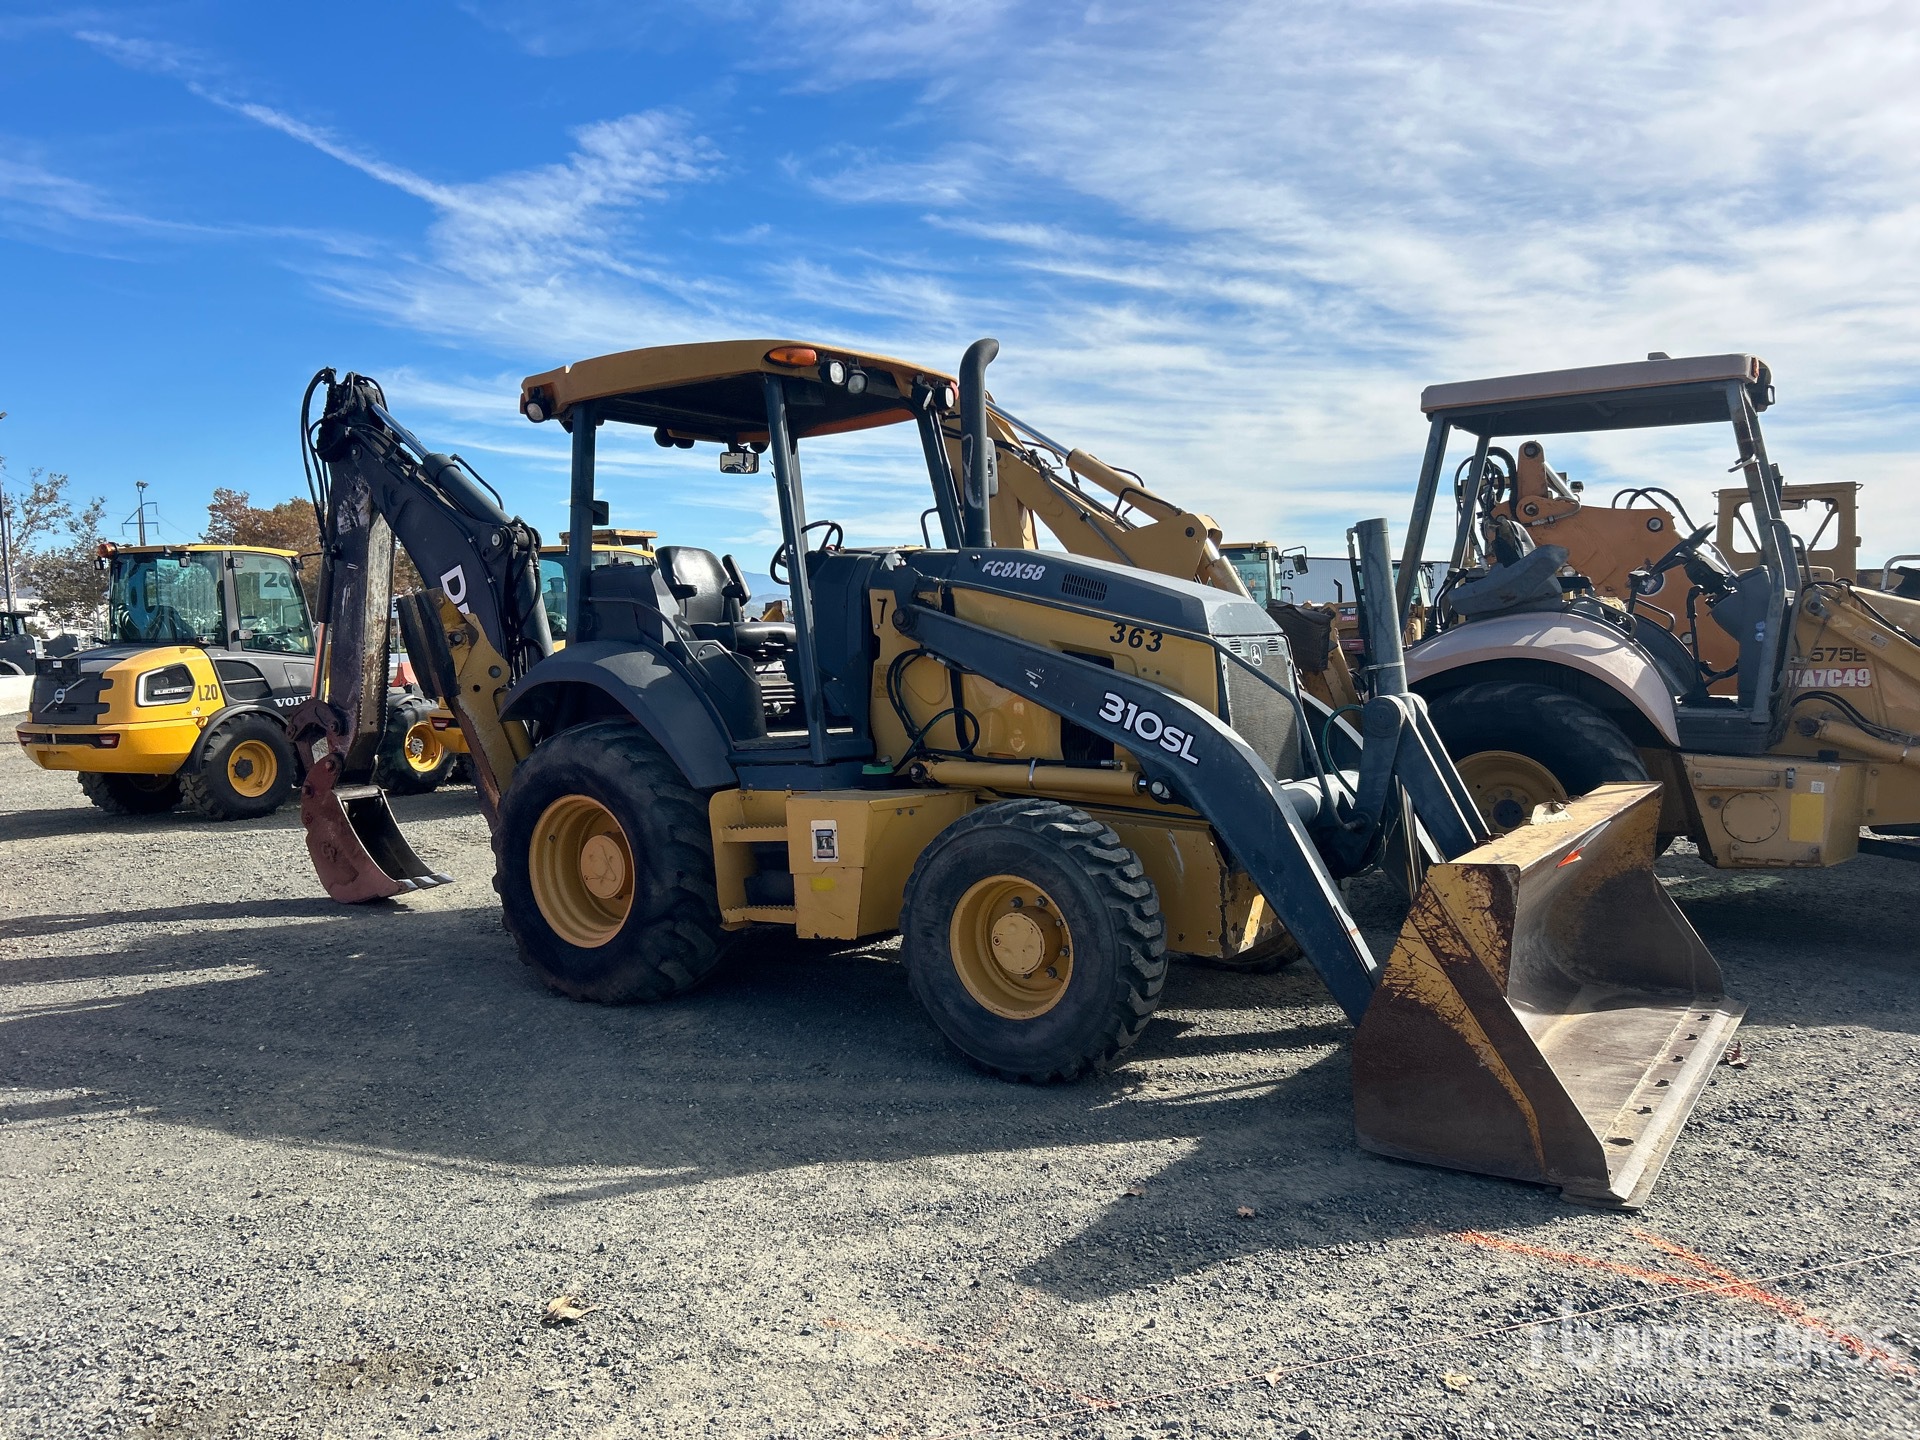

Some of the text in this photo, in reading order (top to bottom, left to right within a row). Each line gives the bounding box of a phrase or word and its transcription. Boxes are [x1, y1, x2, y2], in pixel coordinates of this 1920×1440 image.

[981, 560, 1046, 581] FC8X58
[877, 598, 888, 624] 7
[1109, 621, 1164, 652] 363
[1810, 647, 1866, 662] 575E
[154, 686, 185, 695] ELECTRIC
[197, 684, 218, 701] L20
[1098, 691, 1199, 765] 310SL
